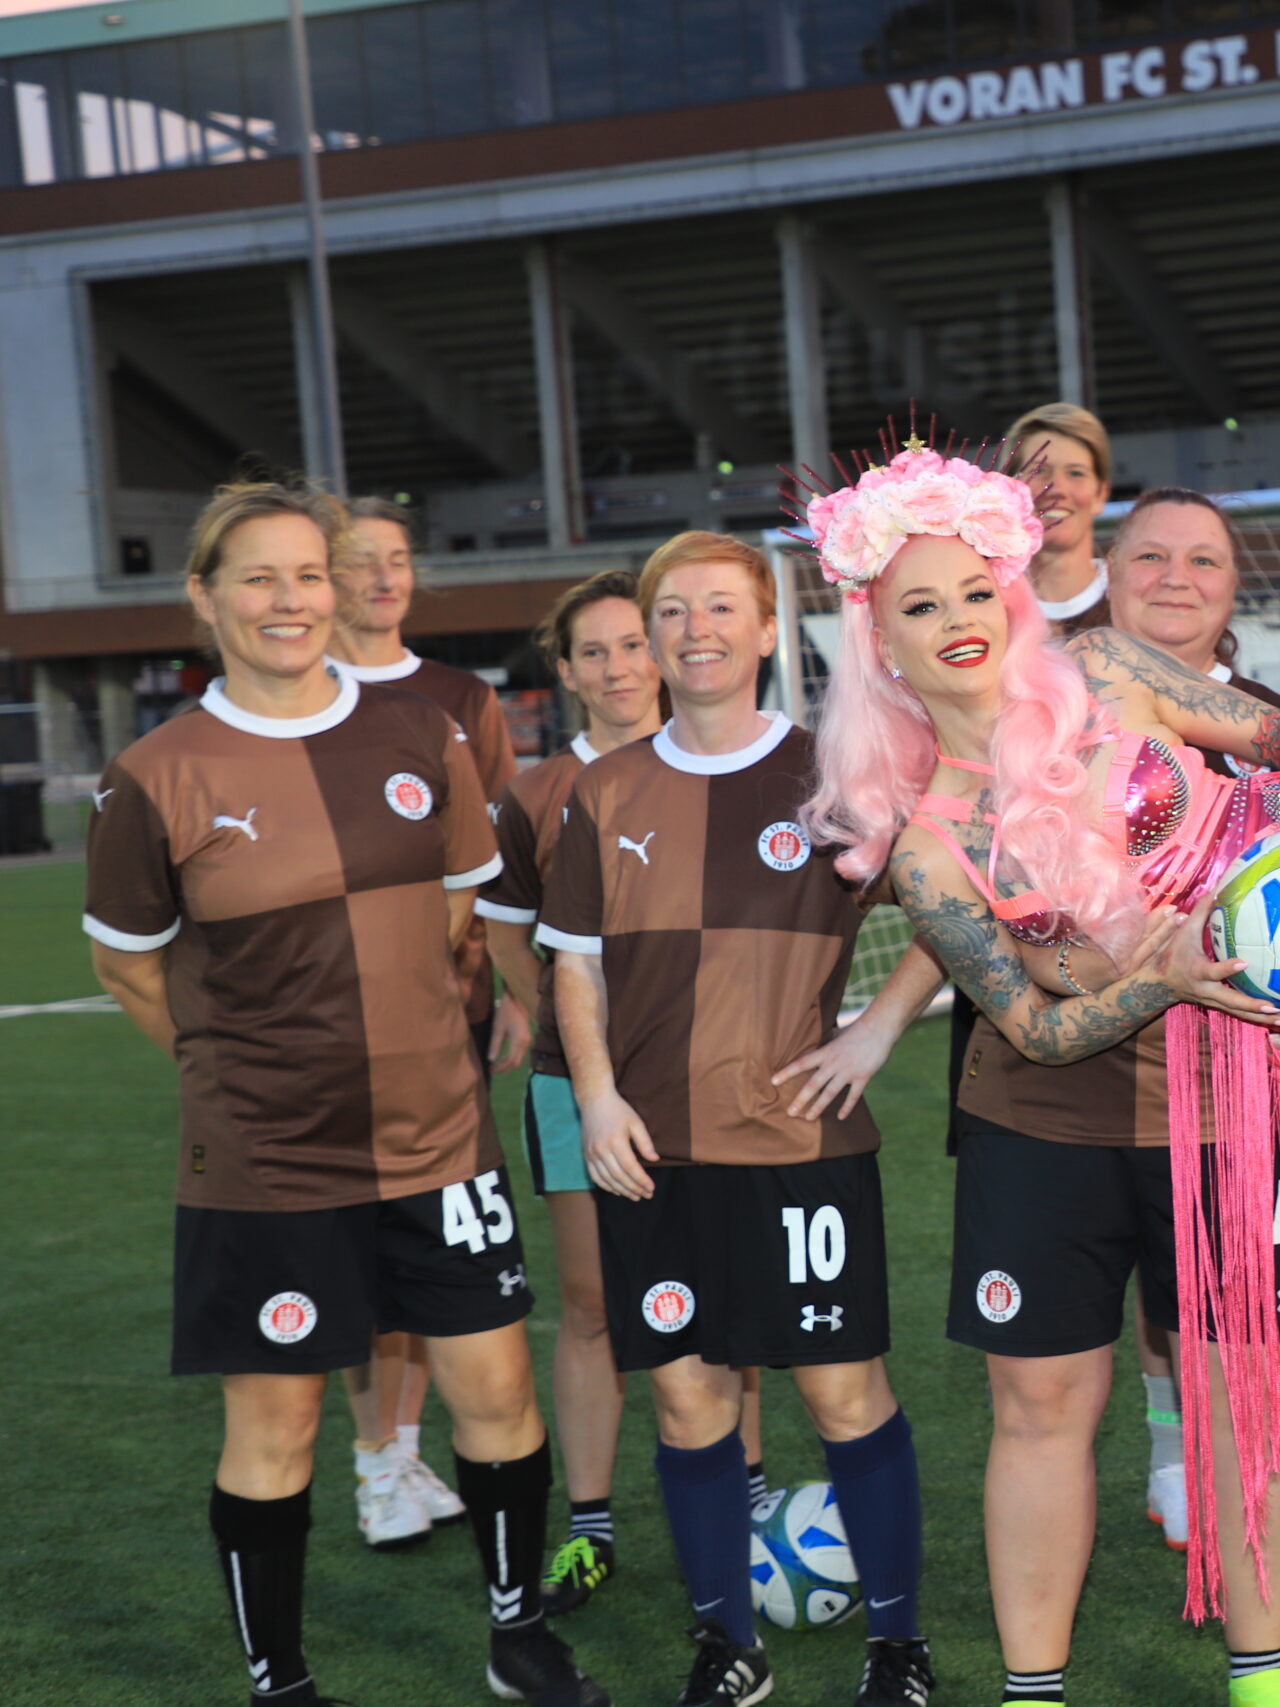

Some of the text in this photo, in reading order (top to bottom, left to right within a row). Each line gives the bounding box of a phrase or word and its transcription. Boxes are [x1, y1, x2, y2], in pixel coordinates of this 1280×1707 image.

[888, 59, 1084, 129] VORAN
[1103, 47, 1166, 99] FC
[1183, 35, 1259, 92] ST.
[442, 1170, 514, 1254] 45
[781, 1204, 846, 1283] 10
